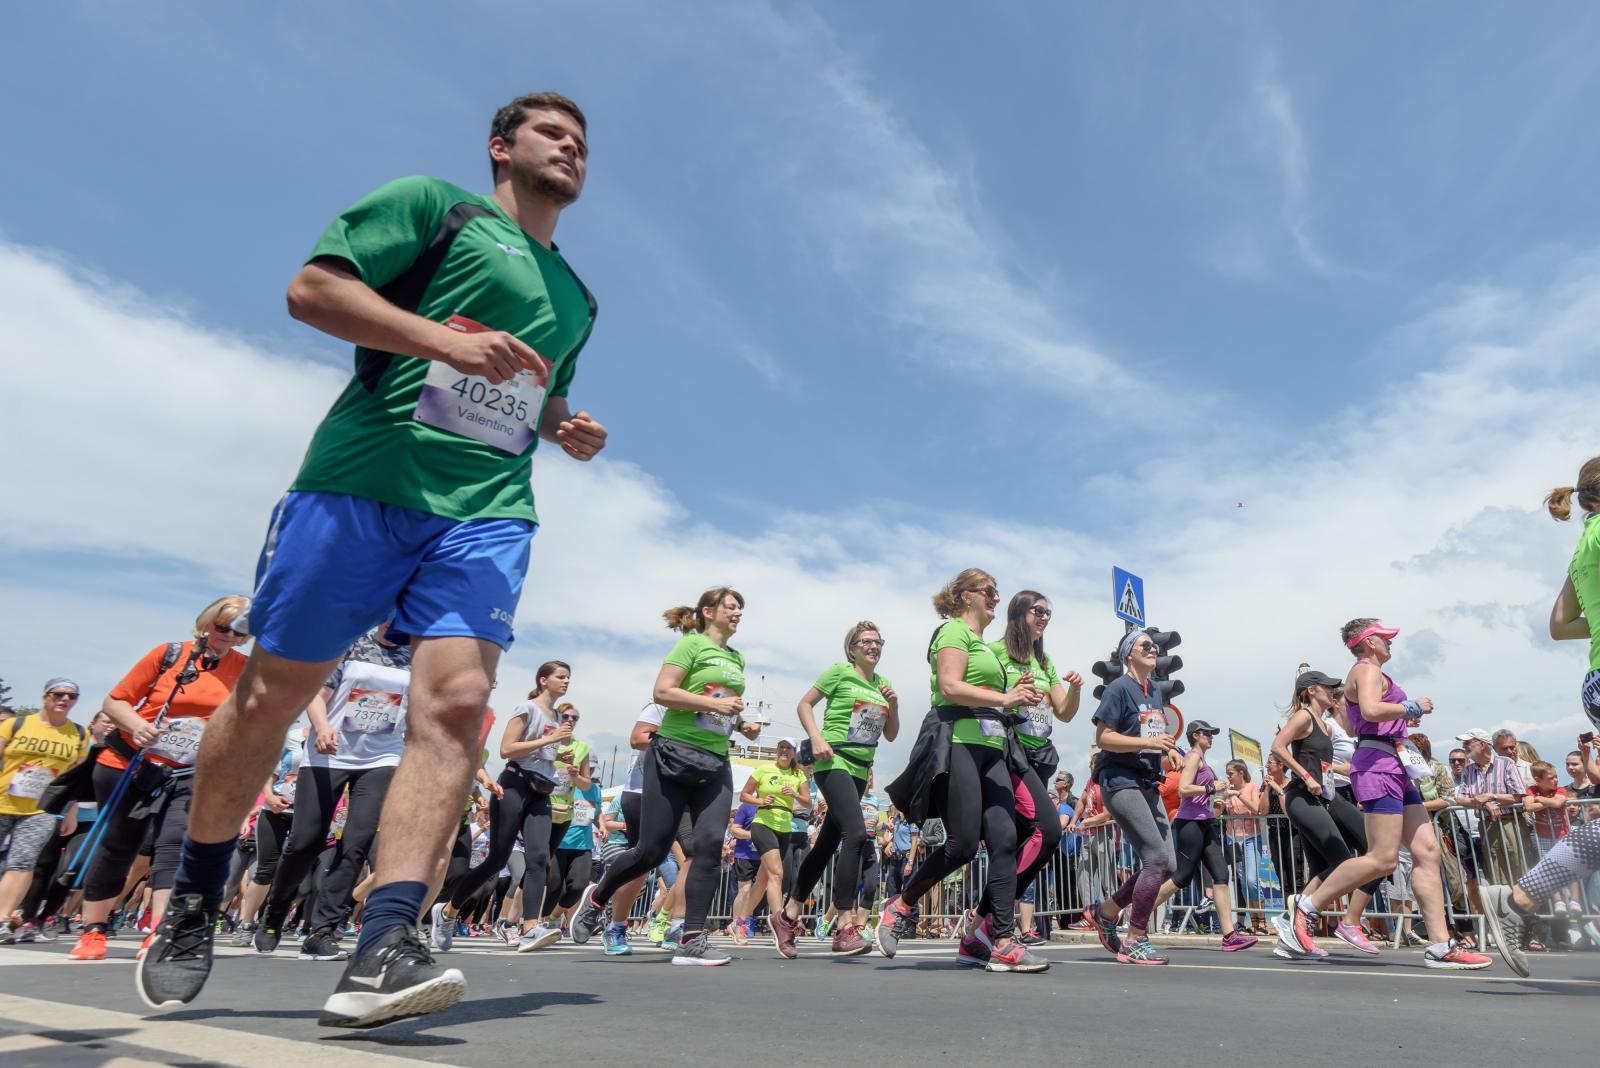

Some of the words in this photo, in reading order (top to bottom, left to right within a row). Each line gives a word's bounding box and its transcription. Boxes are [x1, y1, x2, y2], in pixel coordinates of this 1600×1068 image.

[451, 376, 529, 422] 40235
[457, 405, 514, 437] Valentino
[354, 708, 390, 722] 73773
[14, 735, 74, 758] PROTIV
[160, 732, 201, 752] 39276
